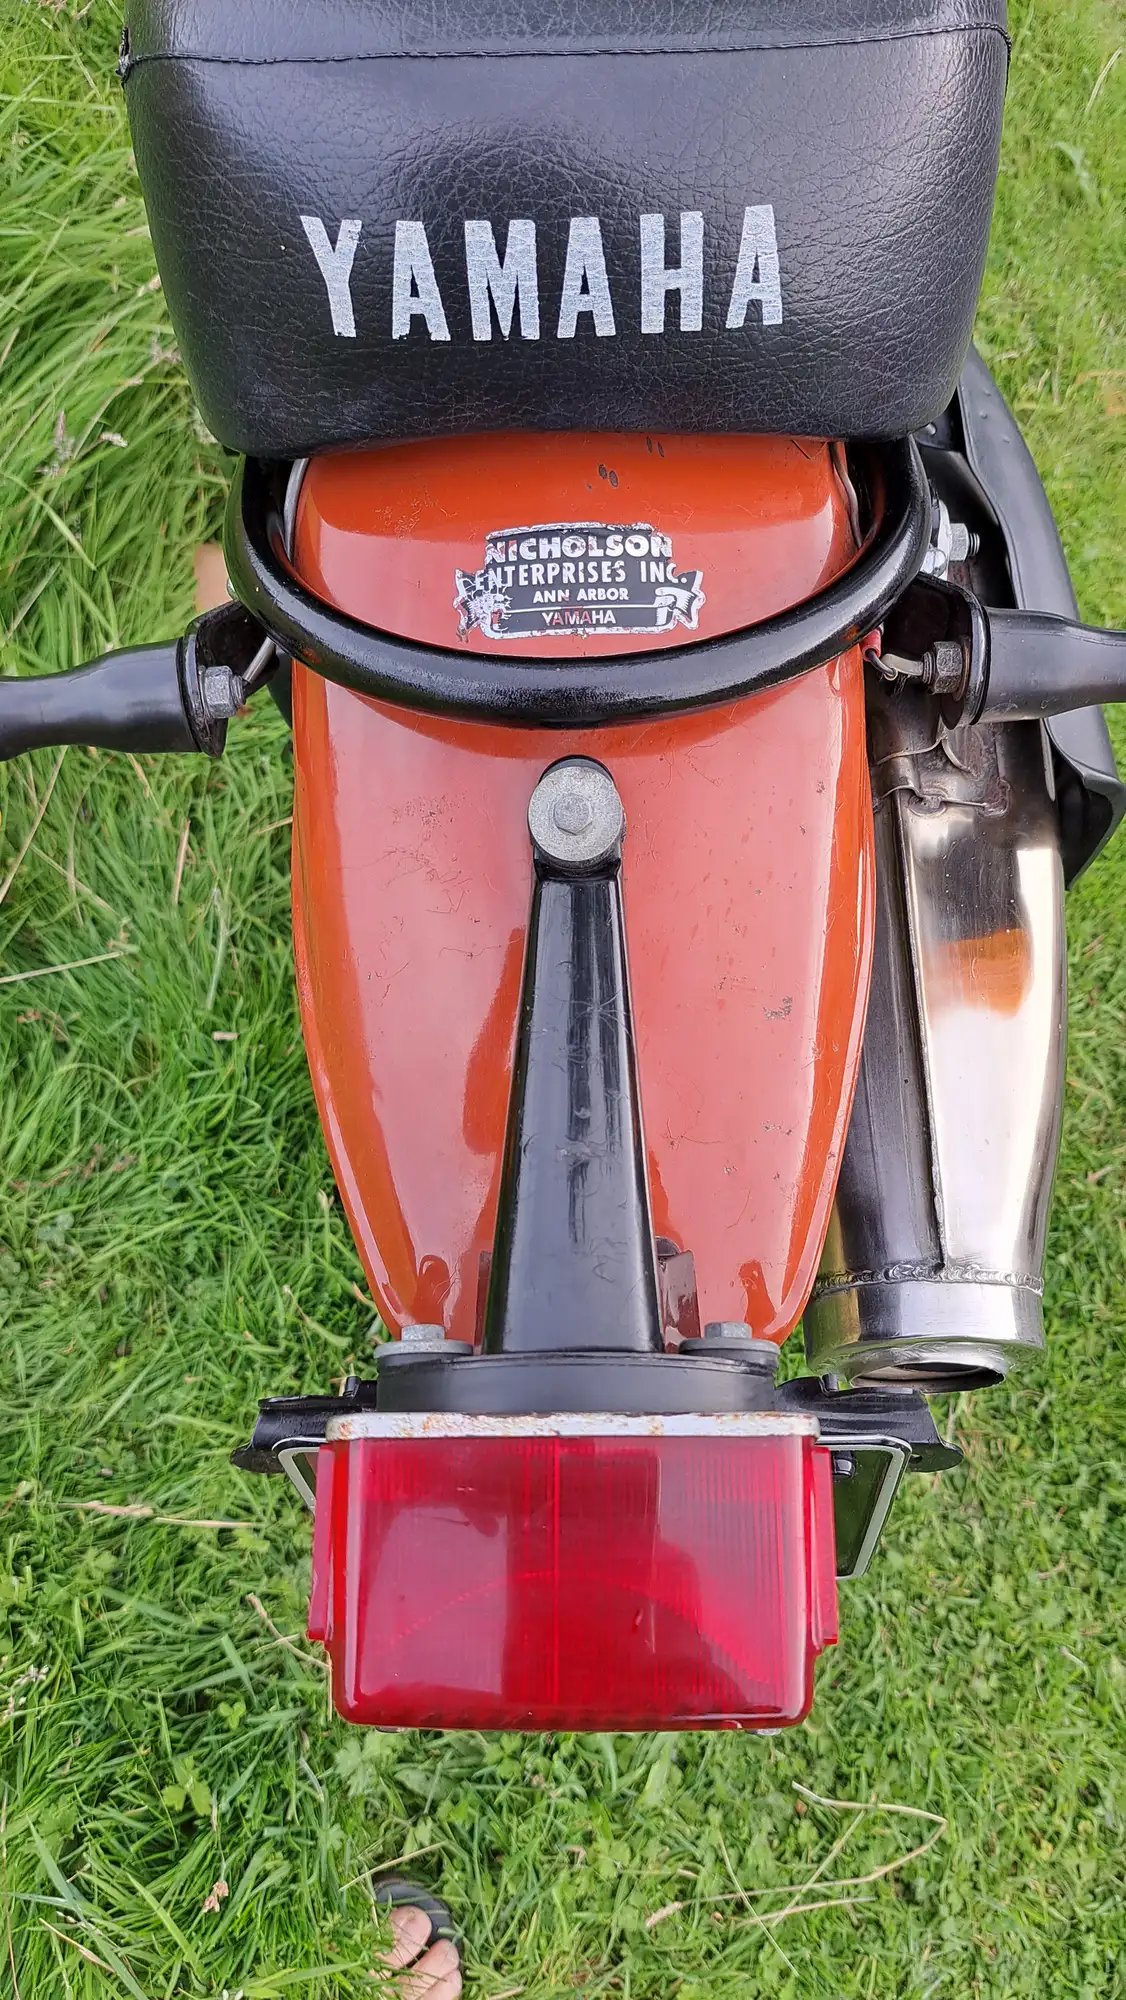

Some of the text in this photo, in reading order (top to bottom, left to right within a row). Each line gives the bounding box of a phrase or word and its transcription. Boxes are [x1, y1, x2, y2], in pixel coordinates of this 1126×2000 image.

[300, 204, 783, 341] YAMAHA
[486, 535, 673, 565] NICHOLSON
[475, 561, 688, 591] ENTERPRISES INC.
[533, 588, 629, 604] ANN ARBOR
[542, 609, 617, 626] YAMAHA
